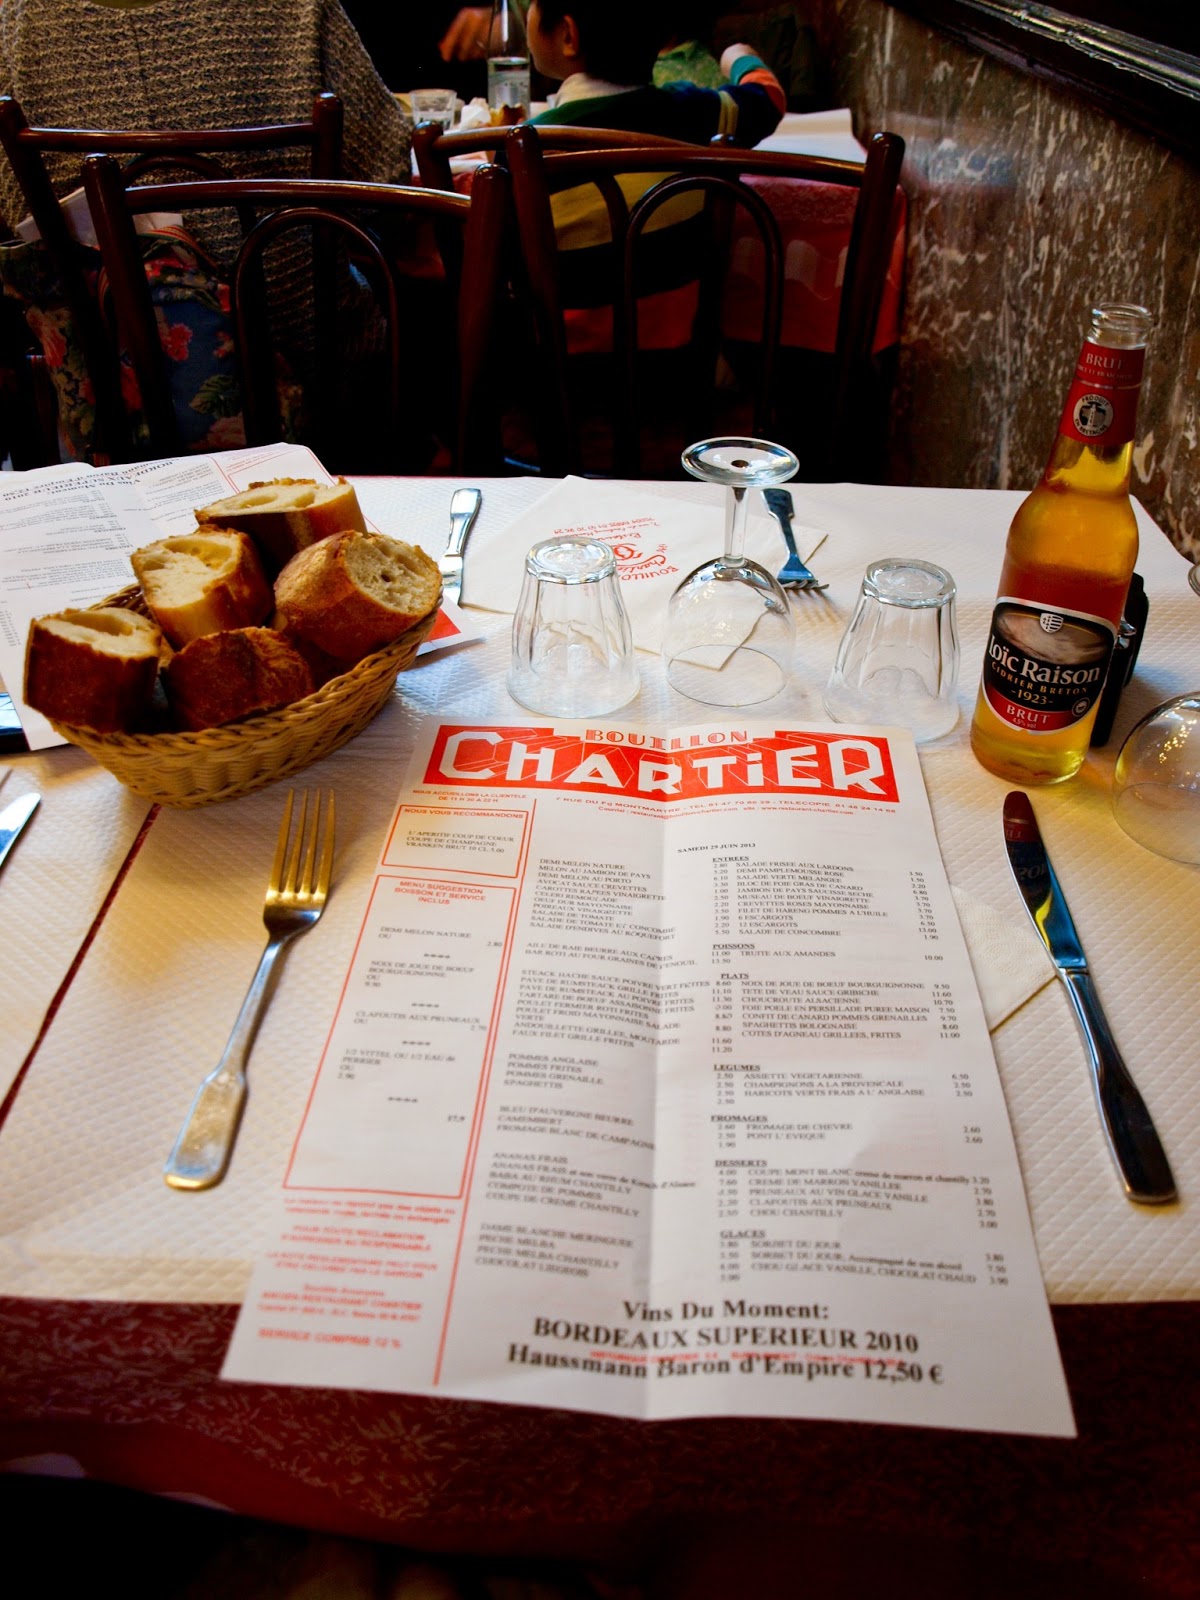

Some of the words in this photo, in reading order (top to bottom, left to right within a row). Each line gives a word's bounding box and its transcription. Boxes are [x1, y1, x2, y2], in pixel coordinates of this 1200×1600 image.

[622, 566, 678, 580] BOUILLO
[989, 634, 1019, 672] Loïc
[1020, 658, 1100, 684] Raison
[992, 662, 1033, 689] CIDRIER
[1040, 686, 1087, 695] BRETON
[1007, 705, 1051, 723] BRUT
[585, 729, 748, 750] BOUILLON
[817, 863, 854, 871] LARDONS
[395, 888, 433, 896] BOISSON
[449, 893, 486, 901] SERVICE
[427, 884, 483, 894] SUGGESTION
[602, 884, 647, 892] CREVETTES
[418, 897, 450, 905] INCLUS
[404, 928, 435, 936] MELON
[559, 980, 615, 990] RUMSTEACK
[617, 985, 646, 994] GRILLE
[650, 990, 679, 998] FRITES
[508, 1062, 548, 1071] POMMES
[550, 1065, 582, 1073] FRITES
[498, 1116, 562, 1125] CAMEMBERT
[720, 1230, 766, 1238] GLACES
[623, 1301, 672, 1322] Vins
[682, 1302, 714, 1320] Du
[724, 1300, 829, 1319] Moment:
[534, 1317, 688, 1349] BORDEAUX
[696, 1326, 857, 1349] SUPERIEUR
[865, 1331, 919, 1352] 2010
[507, 1343, 647, 1378] Haussmann
[656, 1358, 730, 1378] Baron
[739, 1356, 855, 1381] d'Empire
[864, 1360, 923, 1384] 12,50
[929, 1364, 944, 1384] €
